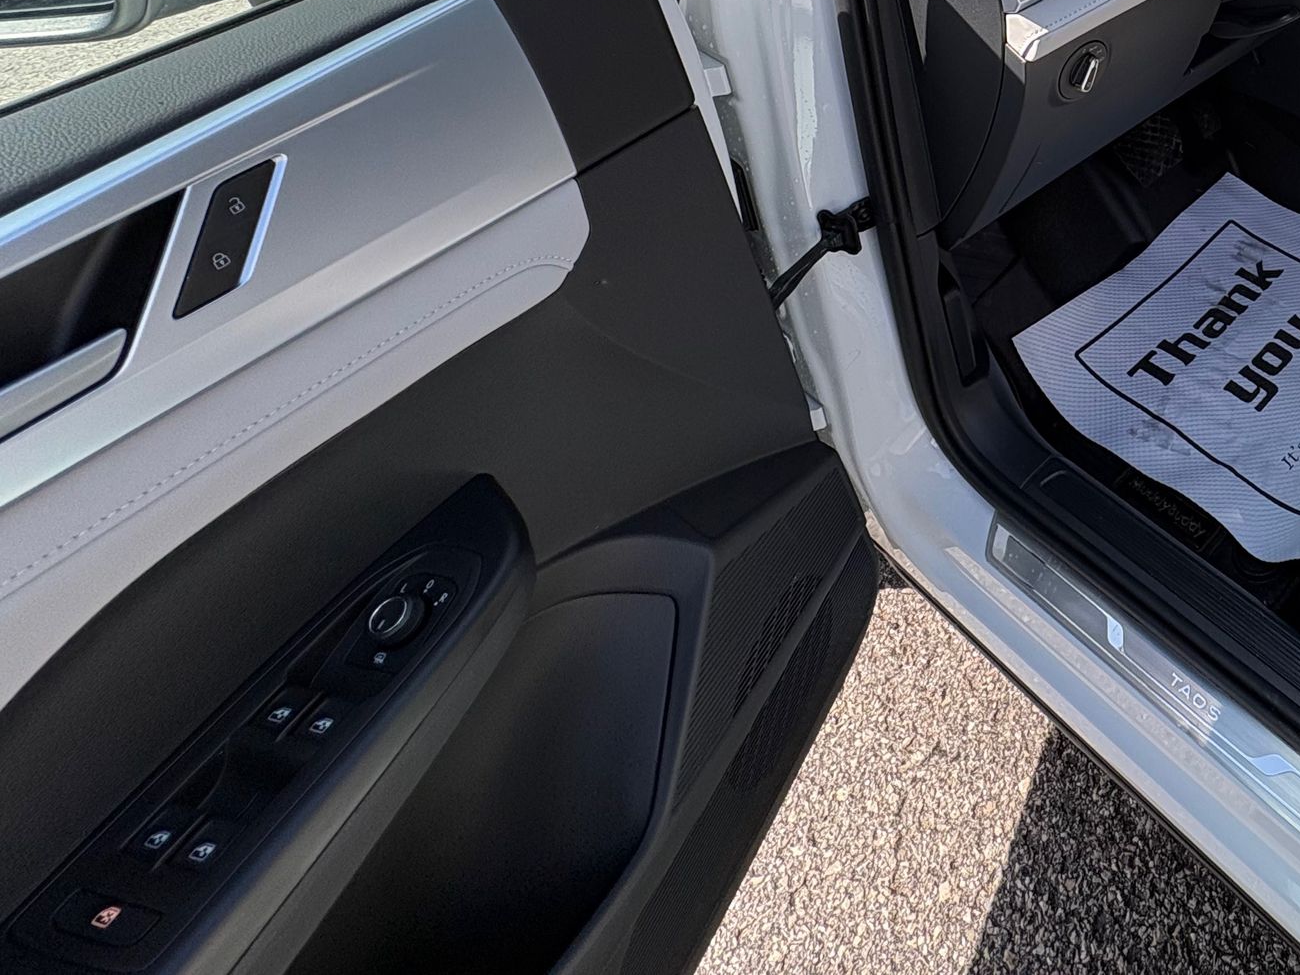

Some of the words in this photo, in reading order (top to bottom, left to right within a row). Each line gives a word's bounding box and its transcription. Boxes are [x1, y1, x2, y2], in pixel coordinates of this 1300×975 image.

[1127, 261, 1284, 386] Thank
[439, 592, 448, 603] R
[1171, 673, 1221, 721] TAOS
